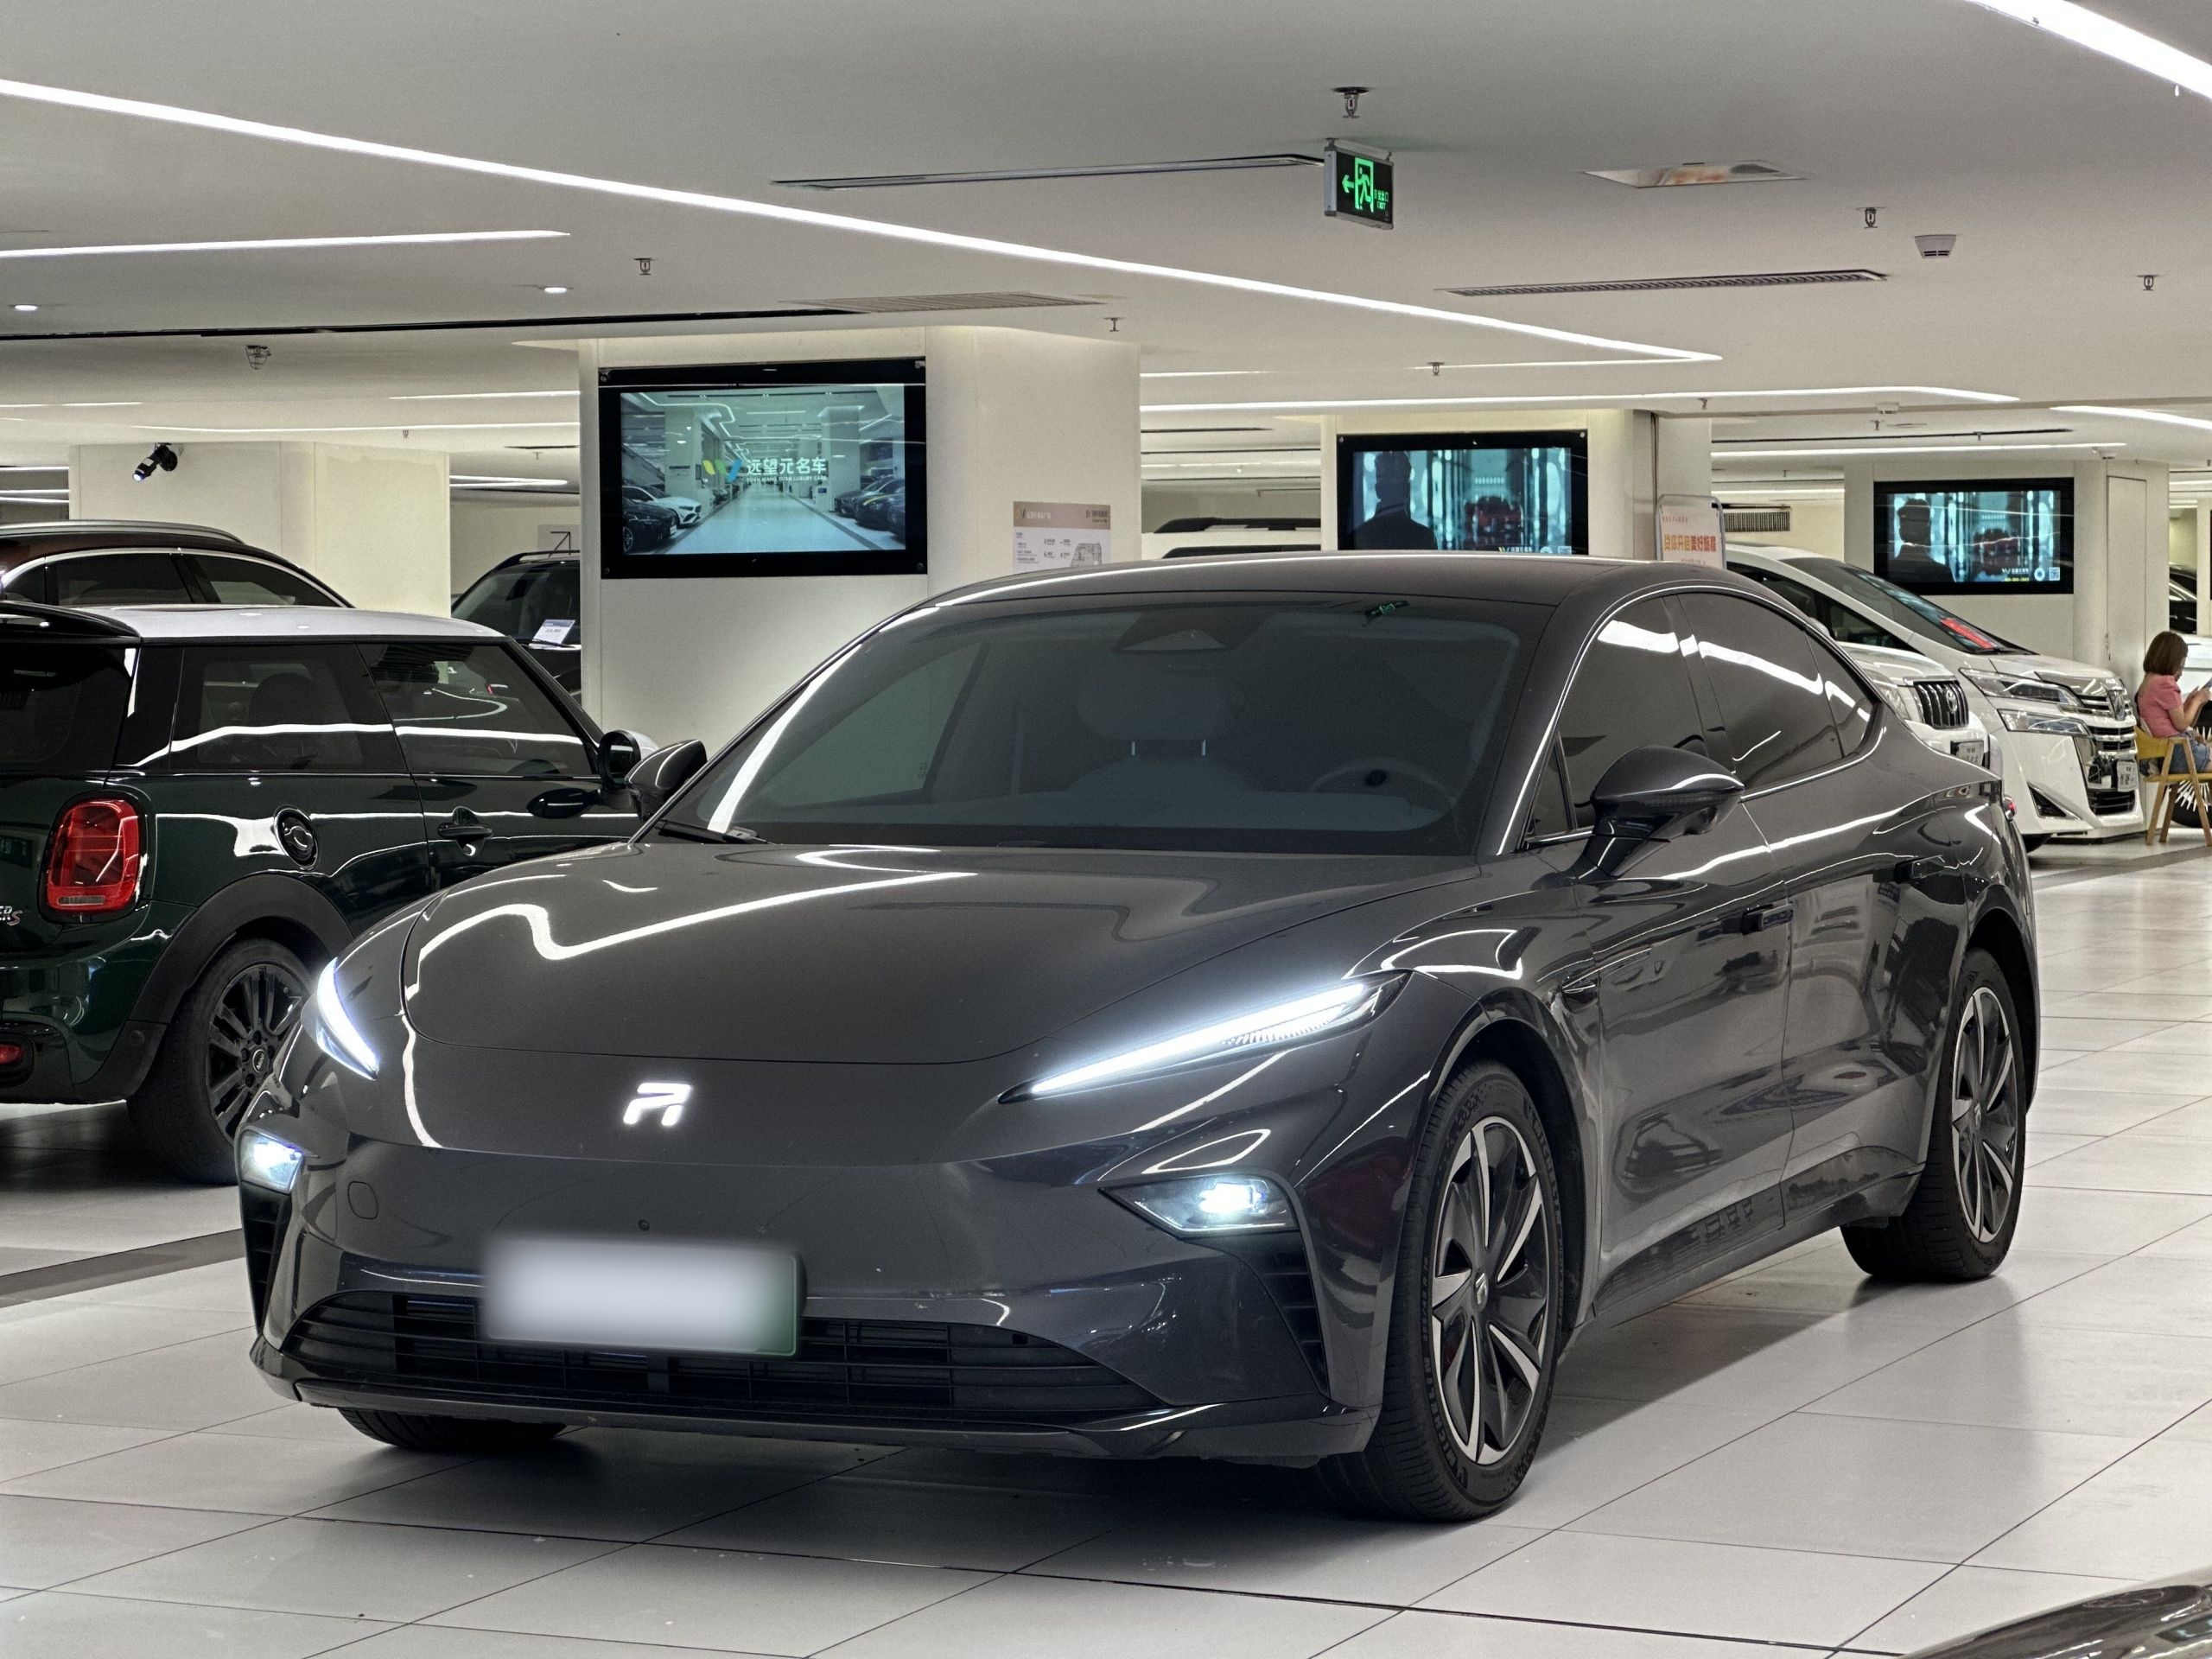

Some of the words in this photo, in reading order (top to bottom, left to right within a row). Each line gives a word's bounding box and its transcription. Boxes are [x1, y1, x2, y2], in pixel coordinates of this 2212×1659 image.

[1376, 200, 1386, 210] EXIT
[747, 457, 827, 475] 远望元名车
[1423, 1356, 1457, 1468] MICHELIN
